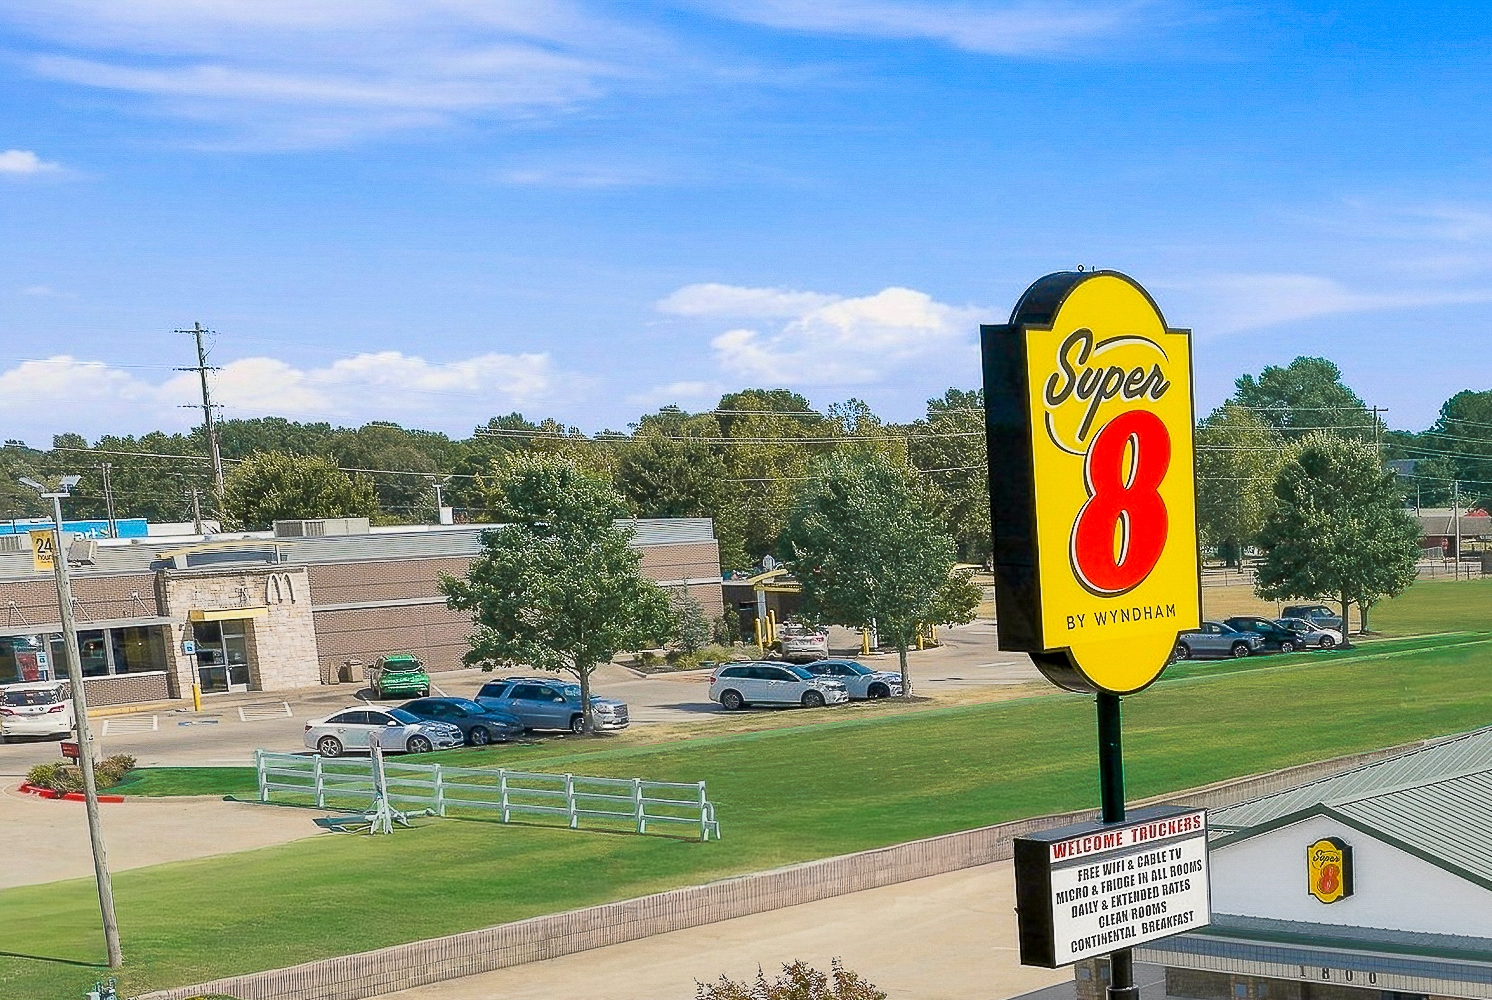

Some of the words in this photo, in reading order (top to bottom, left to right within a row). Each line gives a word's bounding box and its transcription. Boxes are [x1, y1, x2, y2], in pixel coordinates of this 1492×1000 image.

[1045, 328, 1171, 442] Super
[1069, 410, 1171, 598] 8
[36, 537, 54, 554] 24
[1066, 613, 1086, 631] BY
[1094, 603, 1176, 627] WYNDHAM
[1052, 831, 1123, 859] WELCOME
[1130, 814, 1202, 843] TRUCKERS
[1077, 866, 1100, 883] FREE
[1102, 859, 1125, 876] WIFI
[1127, 859, 1135, 871] &
[1137, 851, 1167, 869] CABLE
[1168, 847, 1182, 860] TV
[1312, 849, 1341, 868] Super
[1055, 885, 1089, 905] MICRO
[1091, 884, 1099, 895] &
[1101, 874, 1136, 894] FRIDGE
[1138, 871, 1149, 885] IN
[1151, 867, 1168, 882] ALL
[1169, 859, 1203, 878] ROOMS
[1316, 863, 1341, 895] 8
[1071, 900, 1099, 919] DAILY
[1101, 899, 1109, 911] &
[1111, 885, 1159, 909] EXTENDED
[1162, 878, 1191, 896] RATES
[1098, 909, 1129, 929] CLEAN
[1131, 900, 1167, 921] ROOMS
[1070, 925, 1137, 953] CONTINENTAL
[1141, 910, 1195, 935] BREAKFAST
[1299, 965, 1377, 985] 1800
